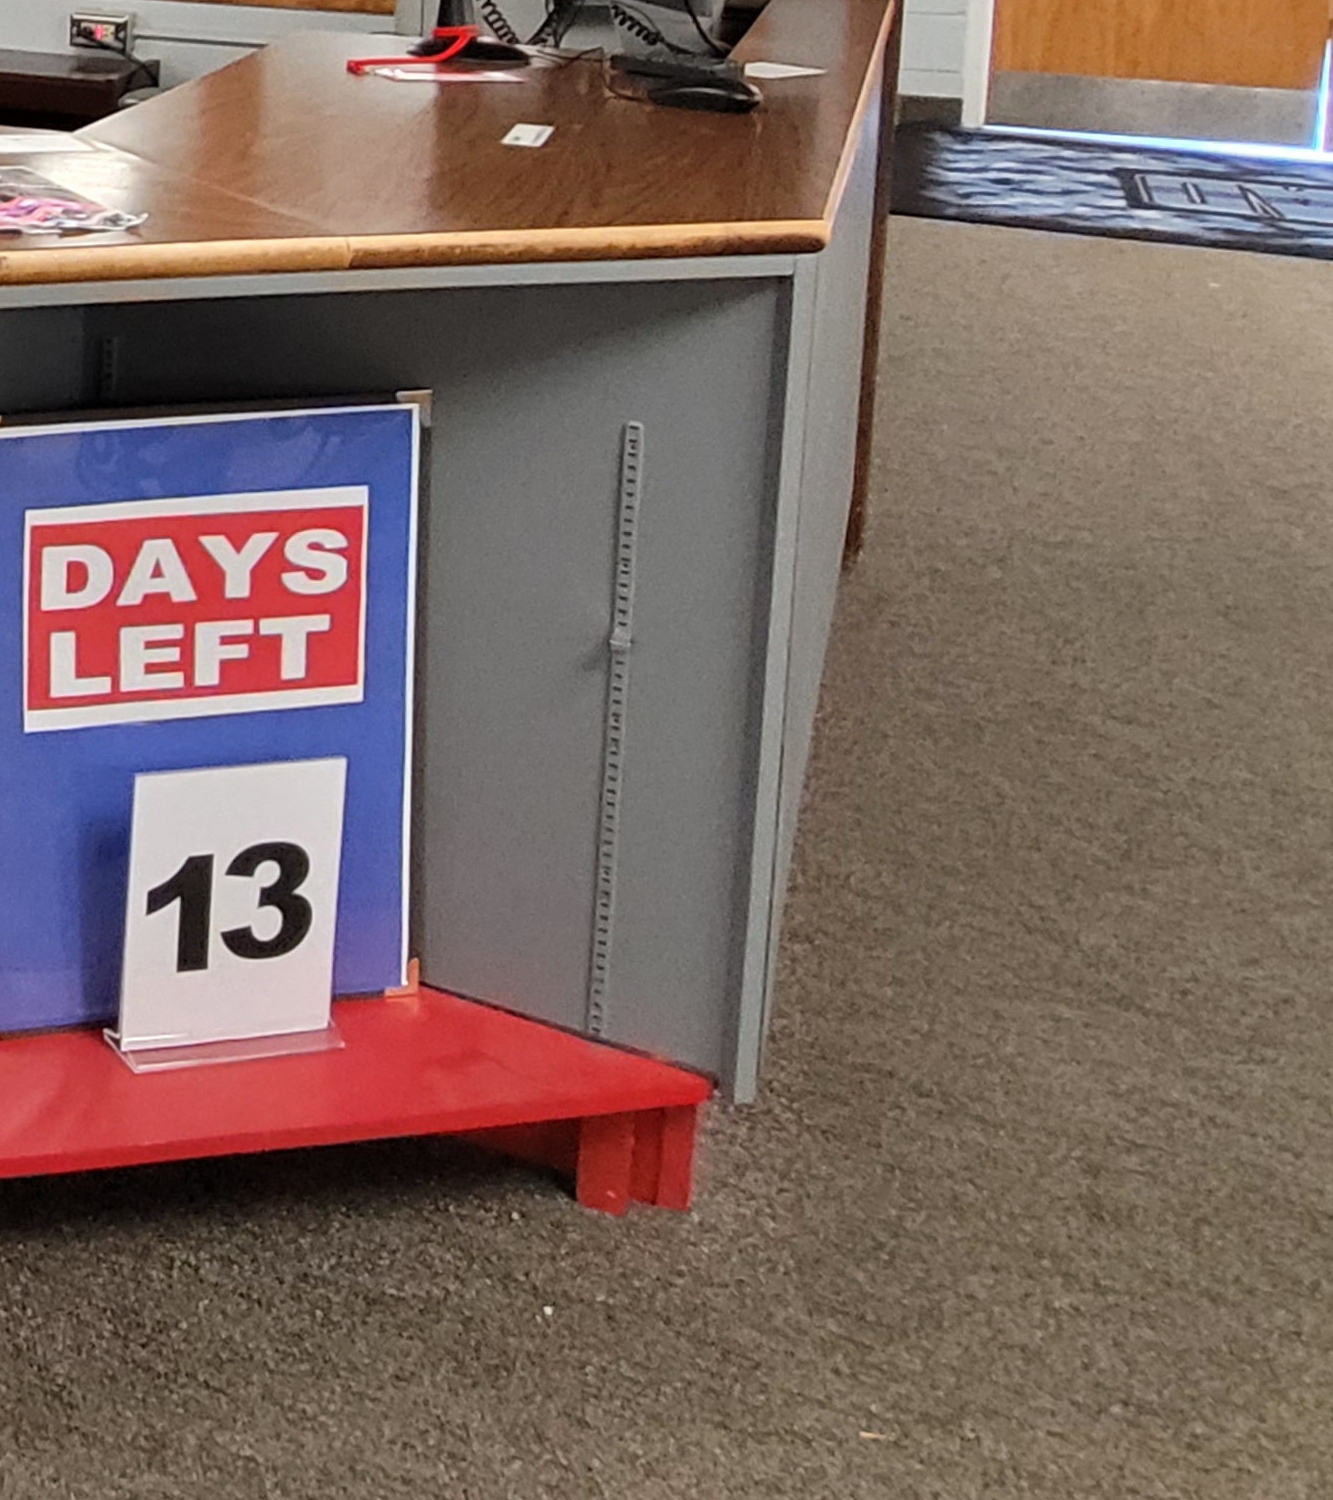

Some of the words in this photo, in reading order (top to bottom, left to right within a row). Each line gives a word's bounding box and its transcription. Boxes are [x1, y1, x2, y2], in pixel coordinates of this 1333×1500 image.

[39, 528, 349, 612] DAYS
[49, 613, 331, 699] LEFT
[145, 840, 314, 974] 13
